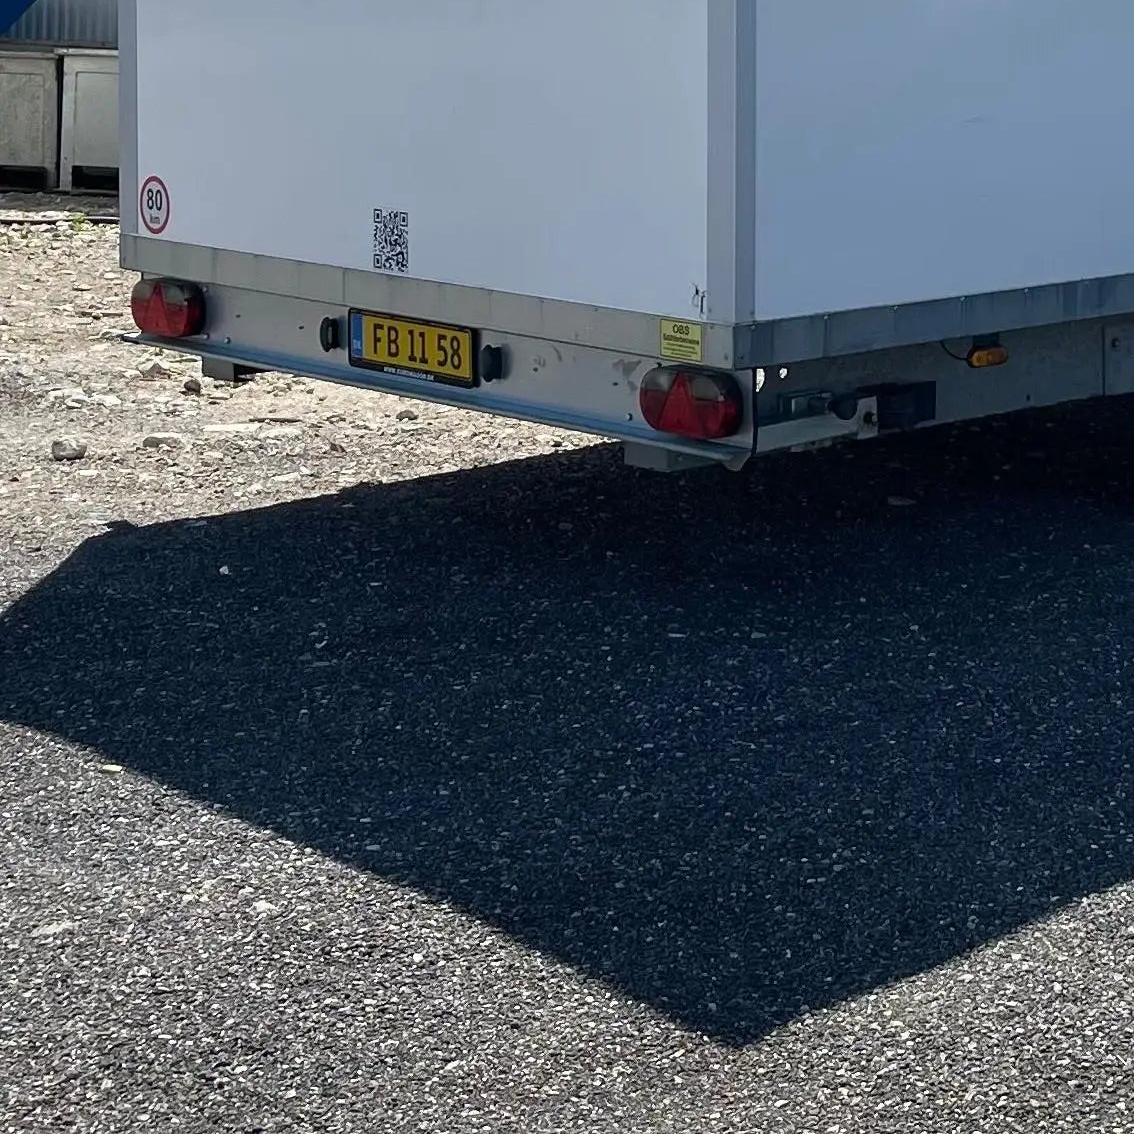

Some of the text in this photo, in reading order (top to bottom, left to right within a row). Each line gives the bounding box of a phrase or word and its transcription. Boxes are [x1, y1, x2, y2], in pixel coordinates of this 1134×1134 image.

[147, 188, 163, 211] 80
[372, 322, 462, 370] FB 11 58
